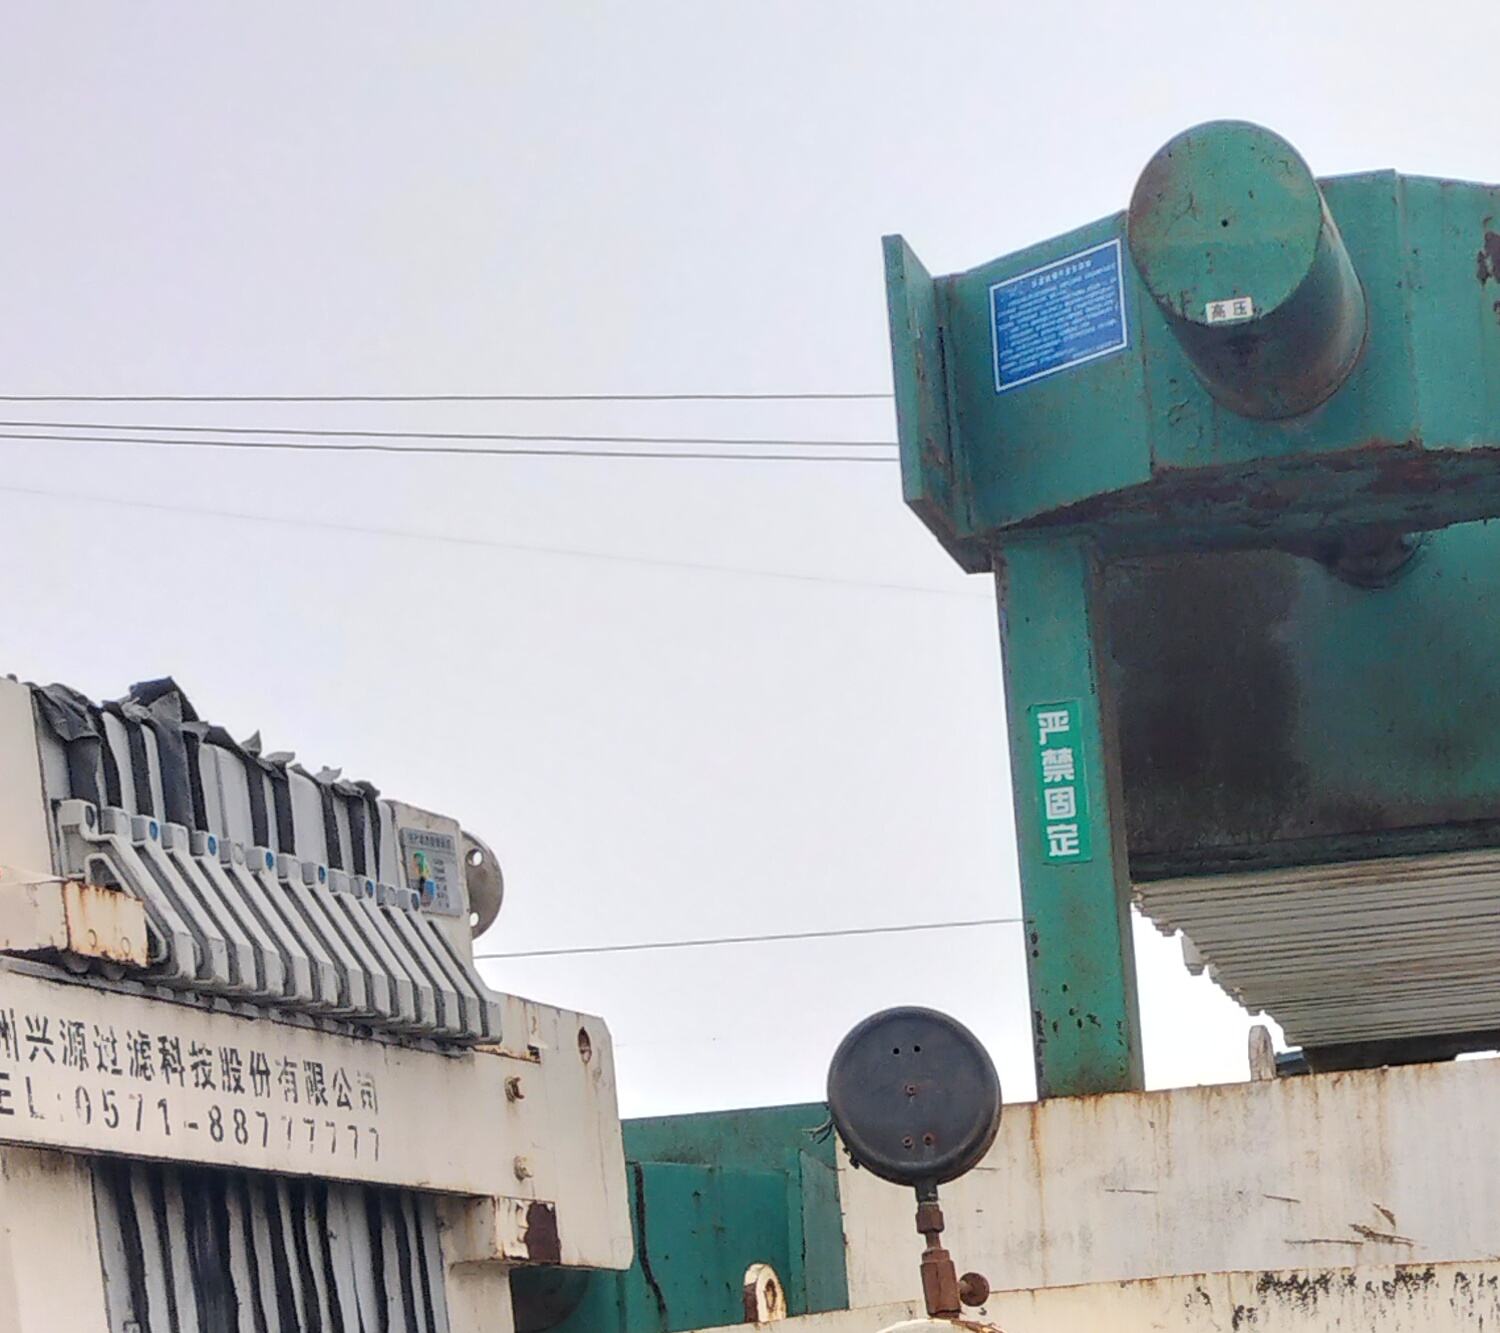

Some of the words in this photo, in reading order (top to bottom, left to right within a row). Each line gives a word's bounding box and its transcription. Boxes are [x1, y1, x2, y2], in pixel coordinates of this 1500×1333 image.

[1211, 301, 1248, 320] 高压
[1037, 709, 1080, 857] 严禁固定
